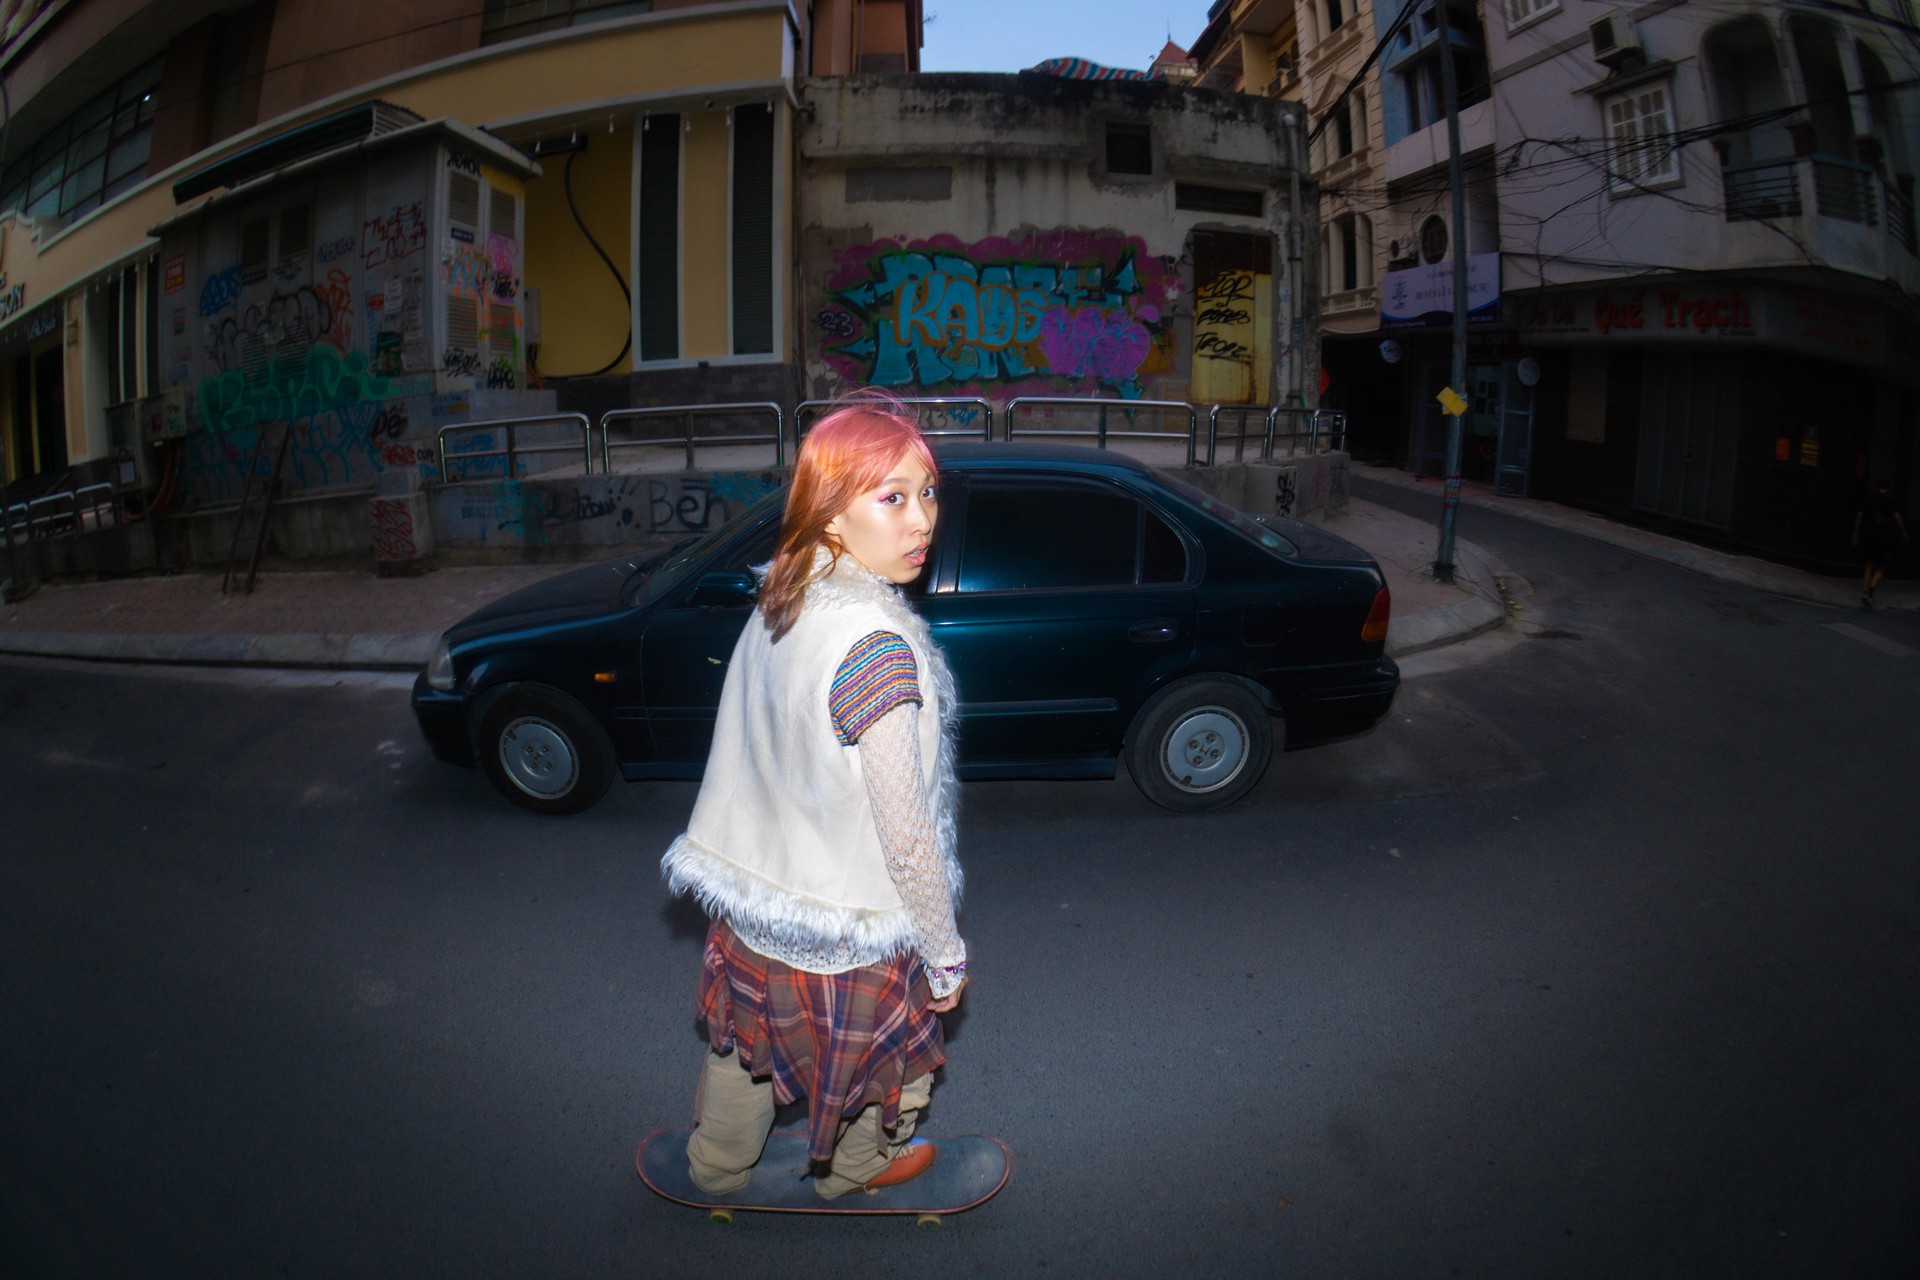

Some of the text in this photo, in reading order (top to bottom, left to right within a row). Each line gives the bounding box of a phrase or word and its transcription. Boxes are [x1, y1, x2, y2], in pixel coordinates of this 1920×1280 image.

[819, 311, 853, 338] 23
[1594, 288, 1647, 334] Quế
[1658, 288, 1752, 334] Trạch
